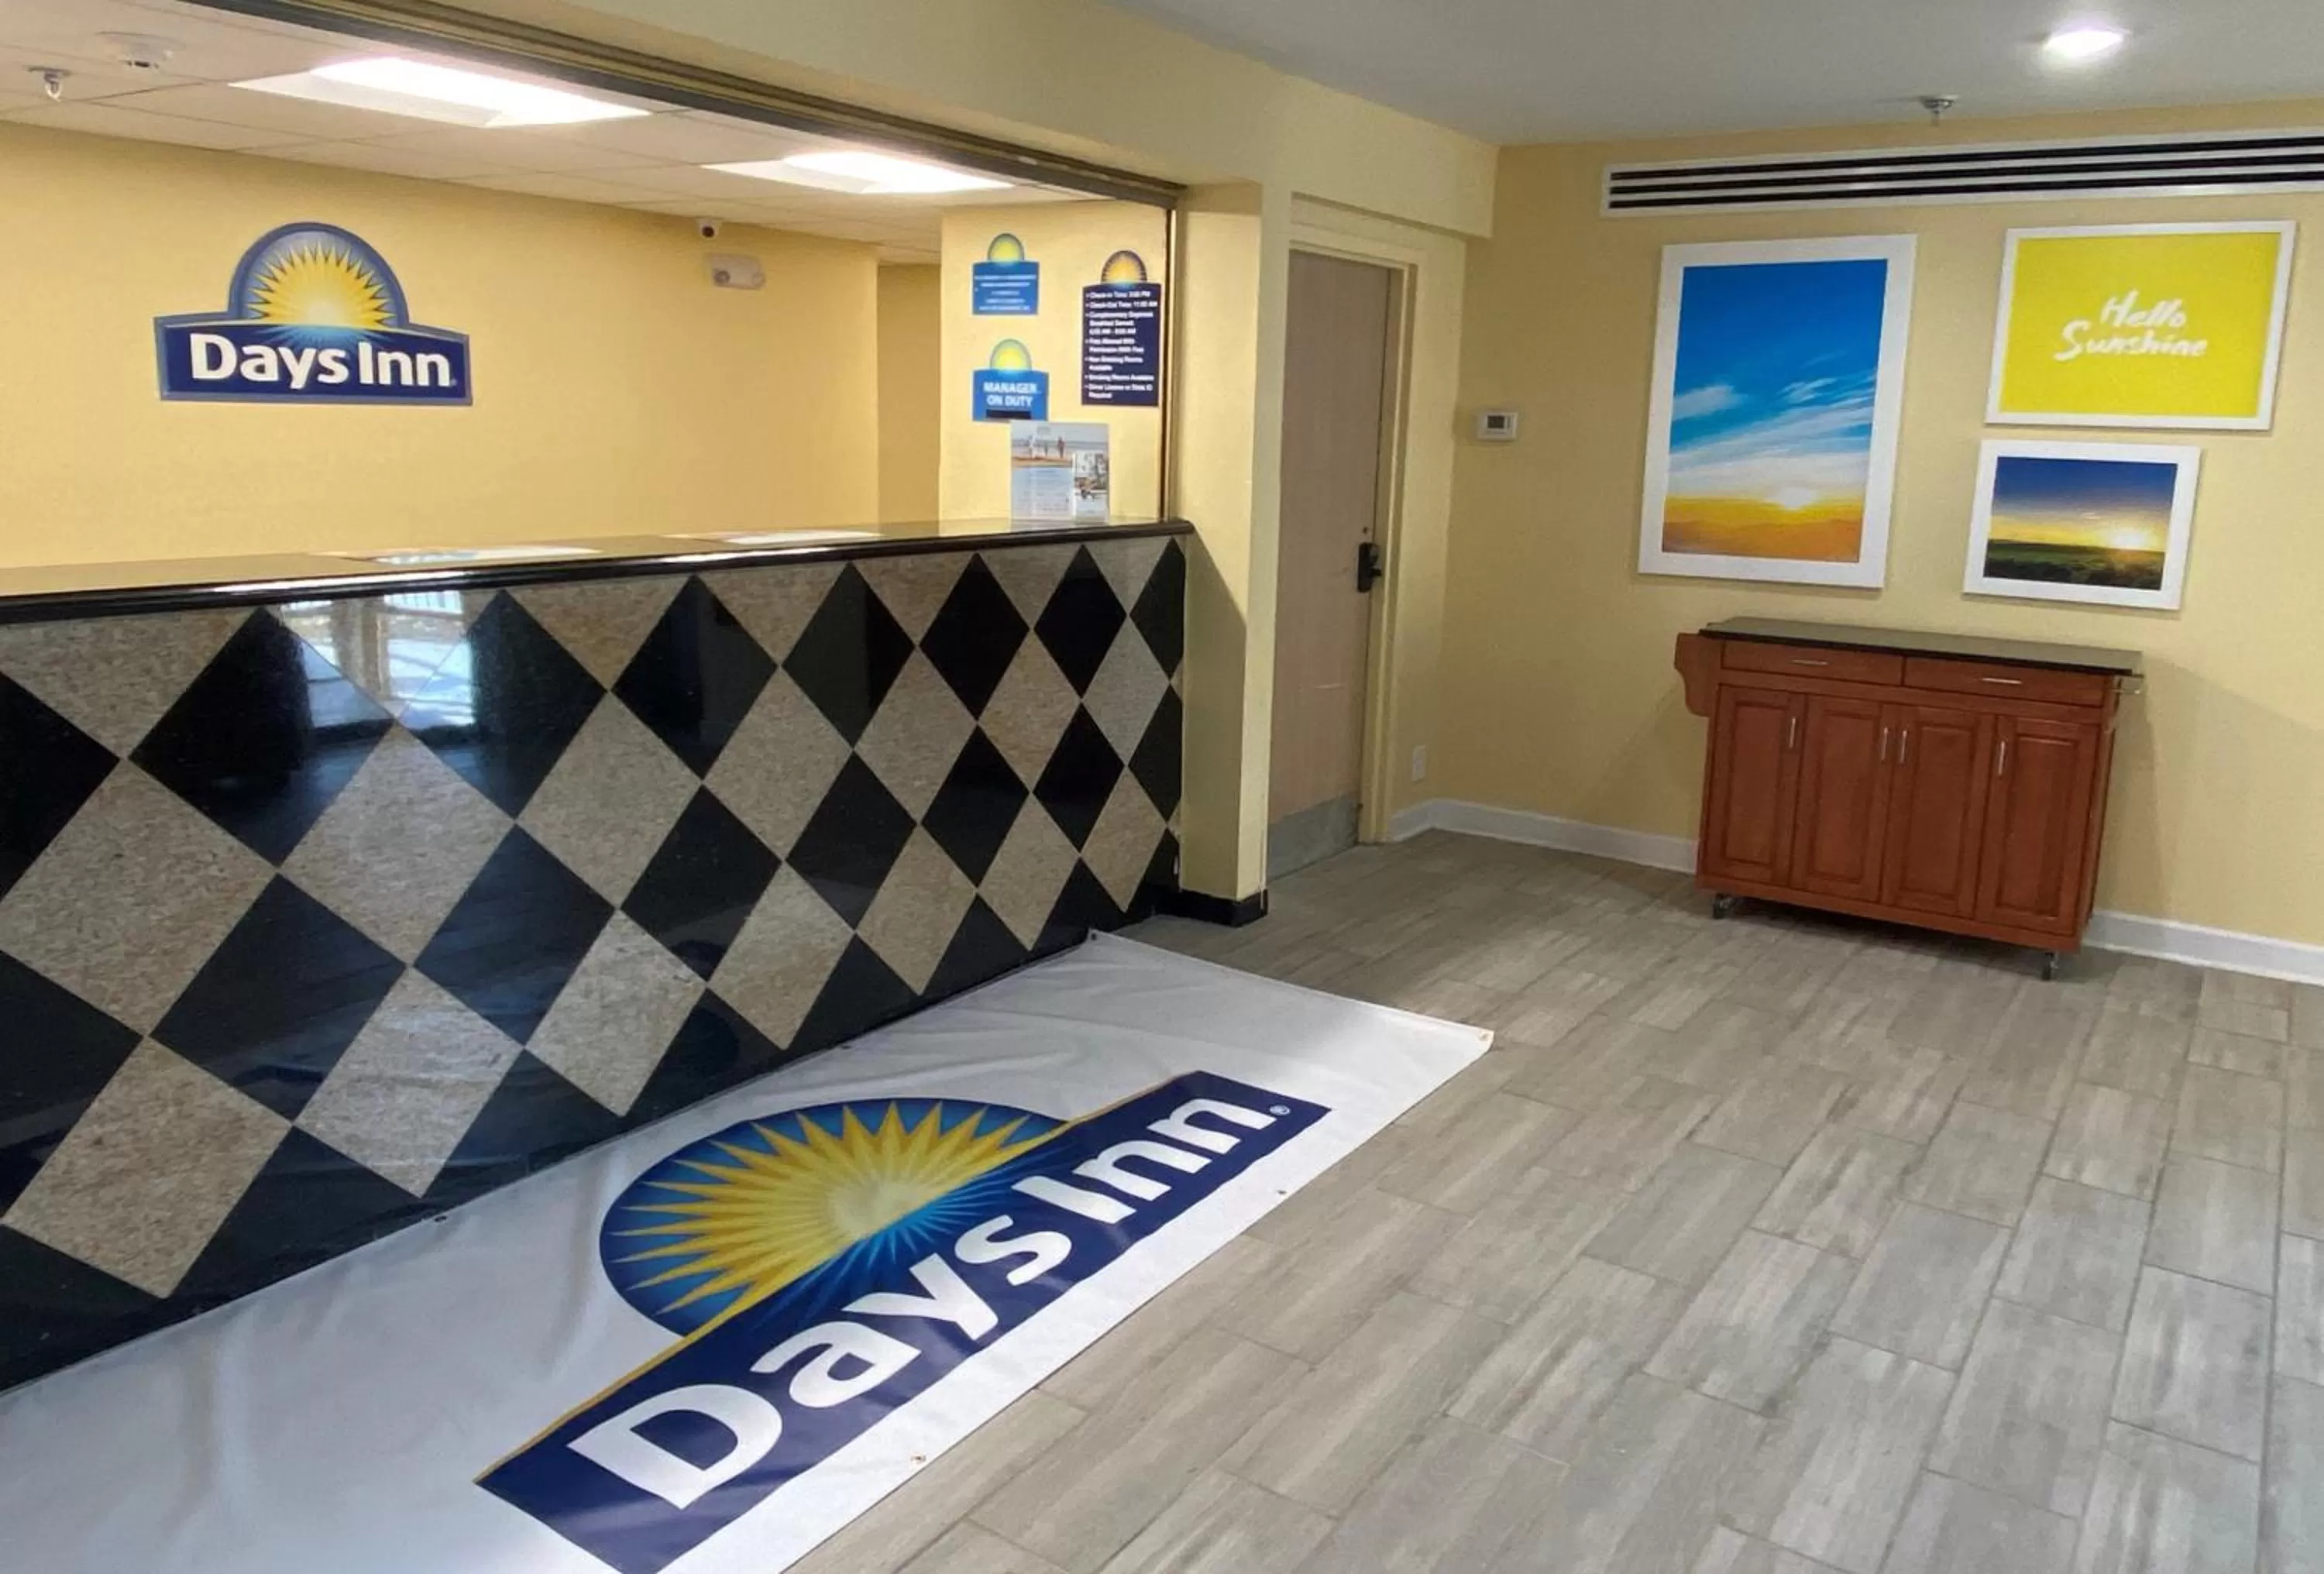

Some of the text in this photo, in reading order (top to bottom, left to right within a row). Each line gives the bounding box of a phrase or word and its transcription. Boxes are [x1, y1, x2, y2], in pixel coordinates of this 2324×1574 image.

[2100, 289, 2188, 328] Hello
[189, 332, 452, 390] Days Inn
[2054, 320, 2208, 362] Sunshine
[983, 381, 1037, 394] MANAGER
[986, 394, 1034, 407] ON DUTY
[568, 1098, 1278, 1510] Days Inn
